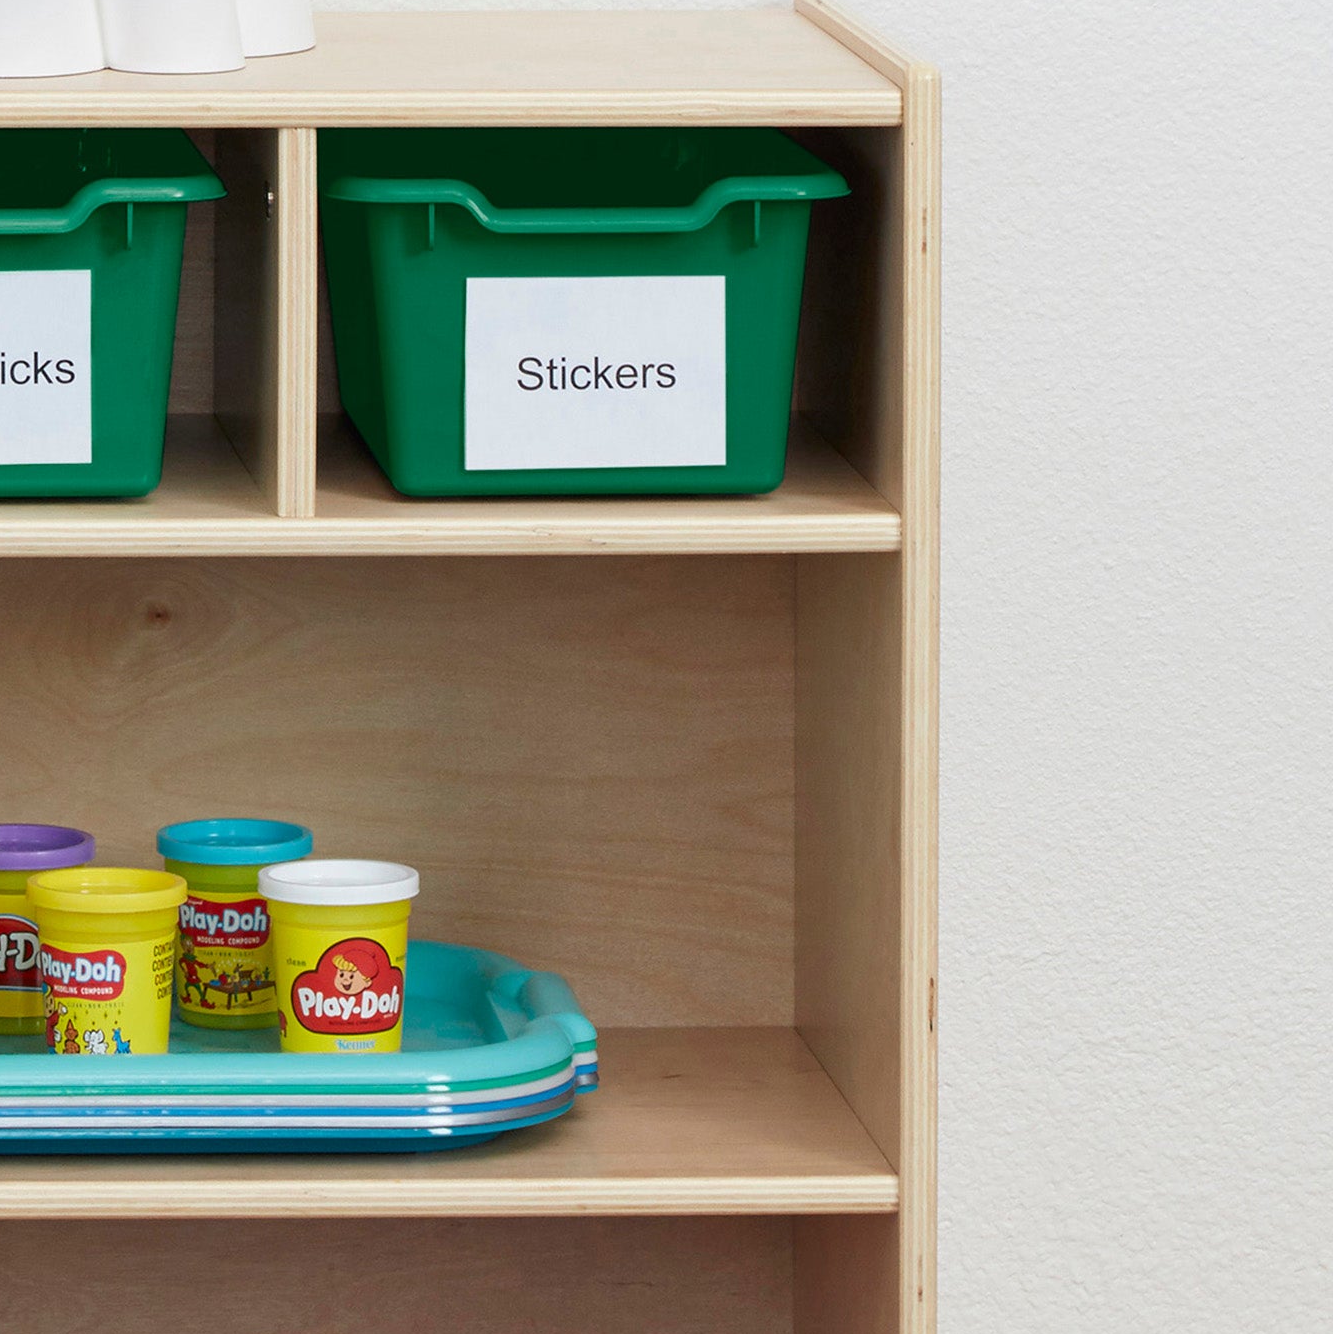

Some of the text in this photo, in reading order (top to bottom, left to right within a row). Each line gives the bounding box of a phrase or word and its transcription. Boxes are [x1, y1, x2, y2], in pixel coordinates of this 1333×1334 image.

[517, 356, 676, 391] Stickers
[196, 935, 260, 945] MODELING COMPOUND
[80, 986, 114, 996] COMPOUND
